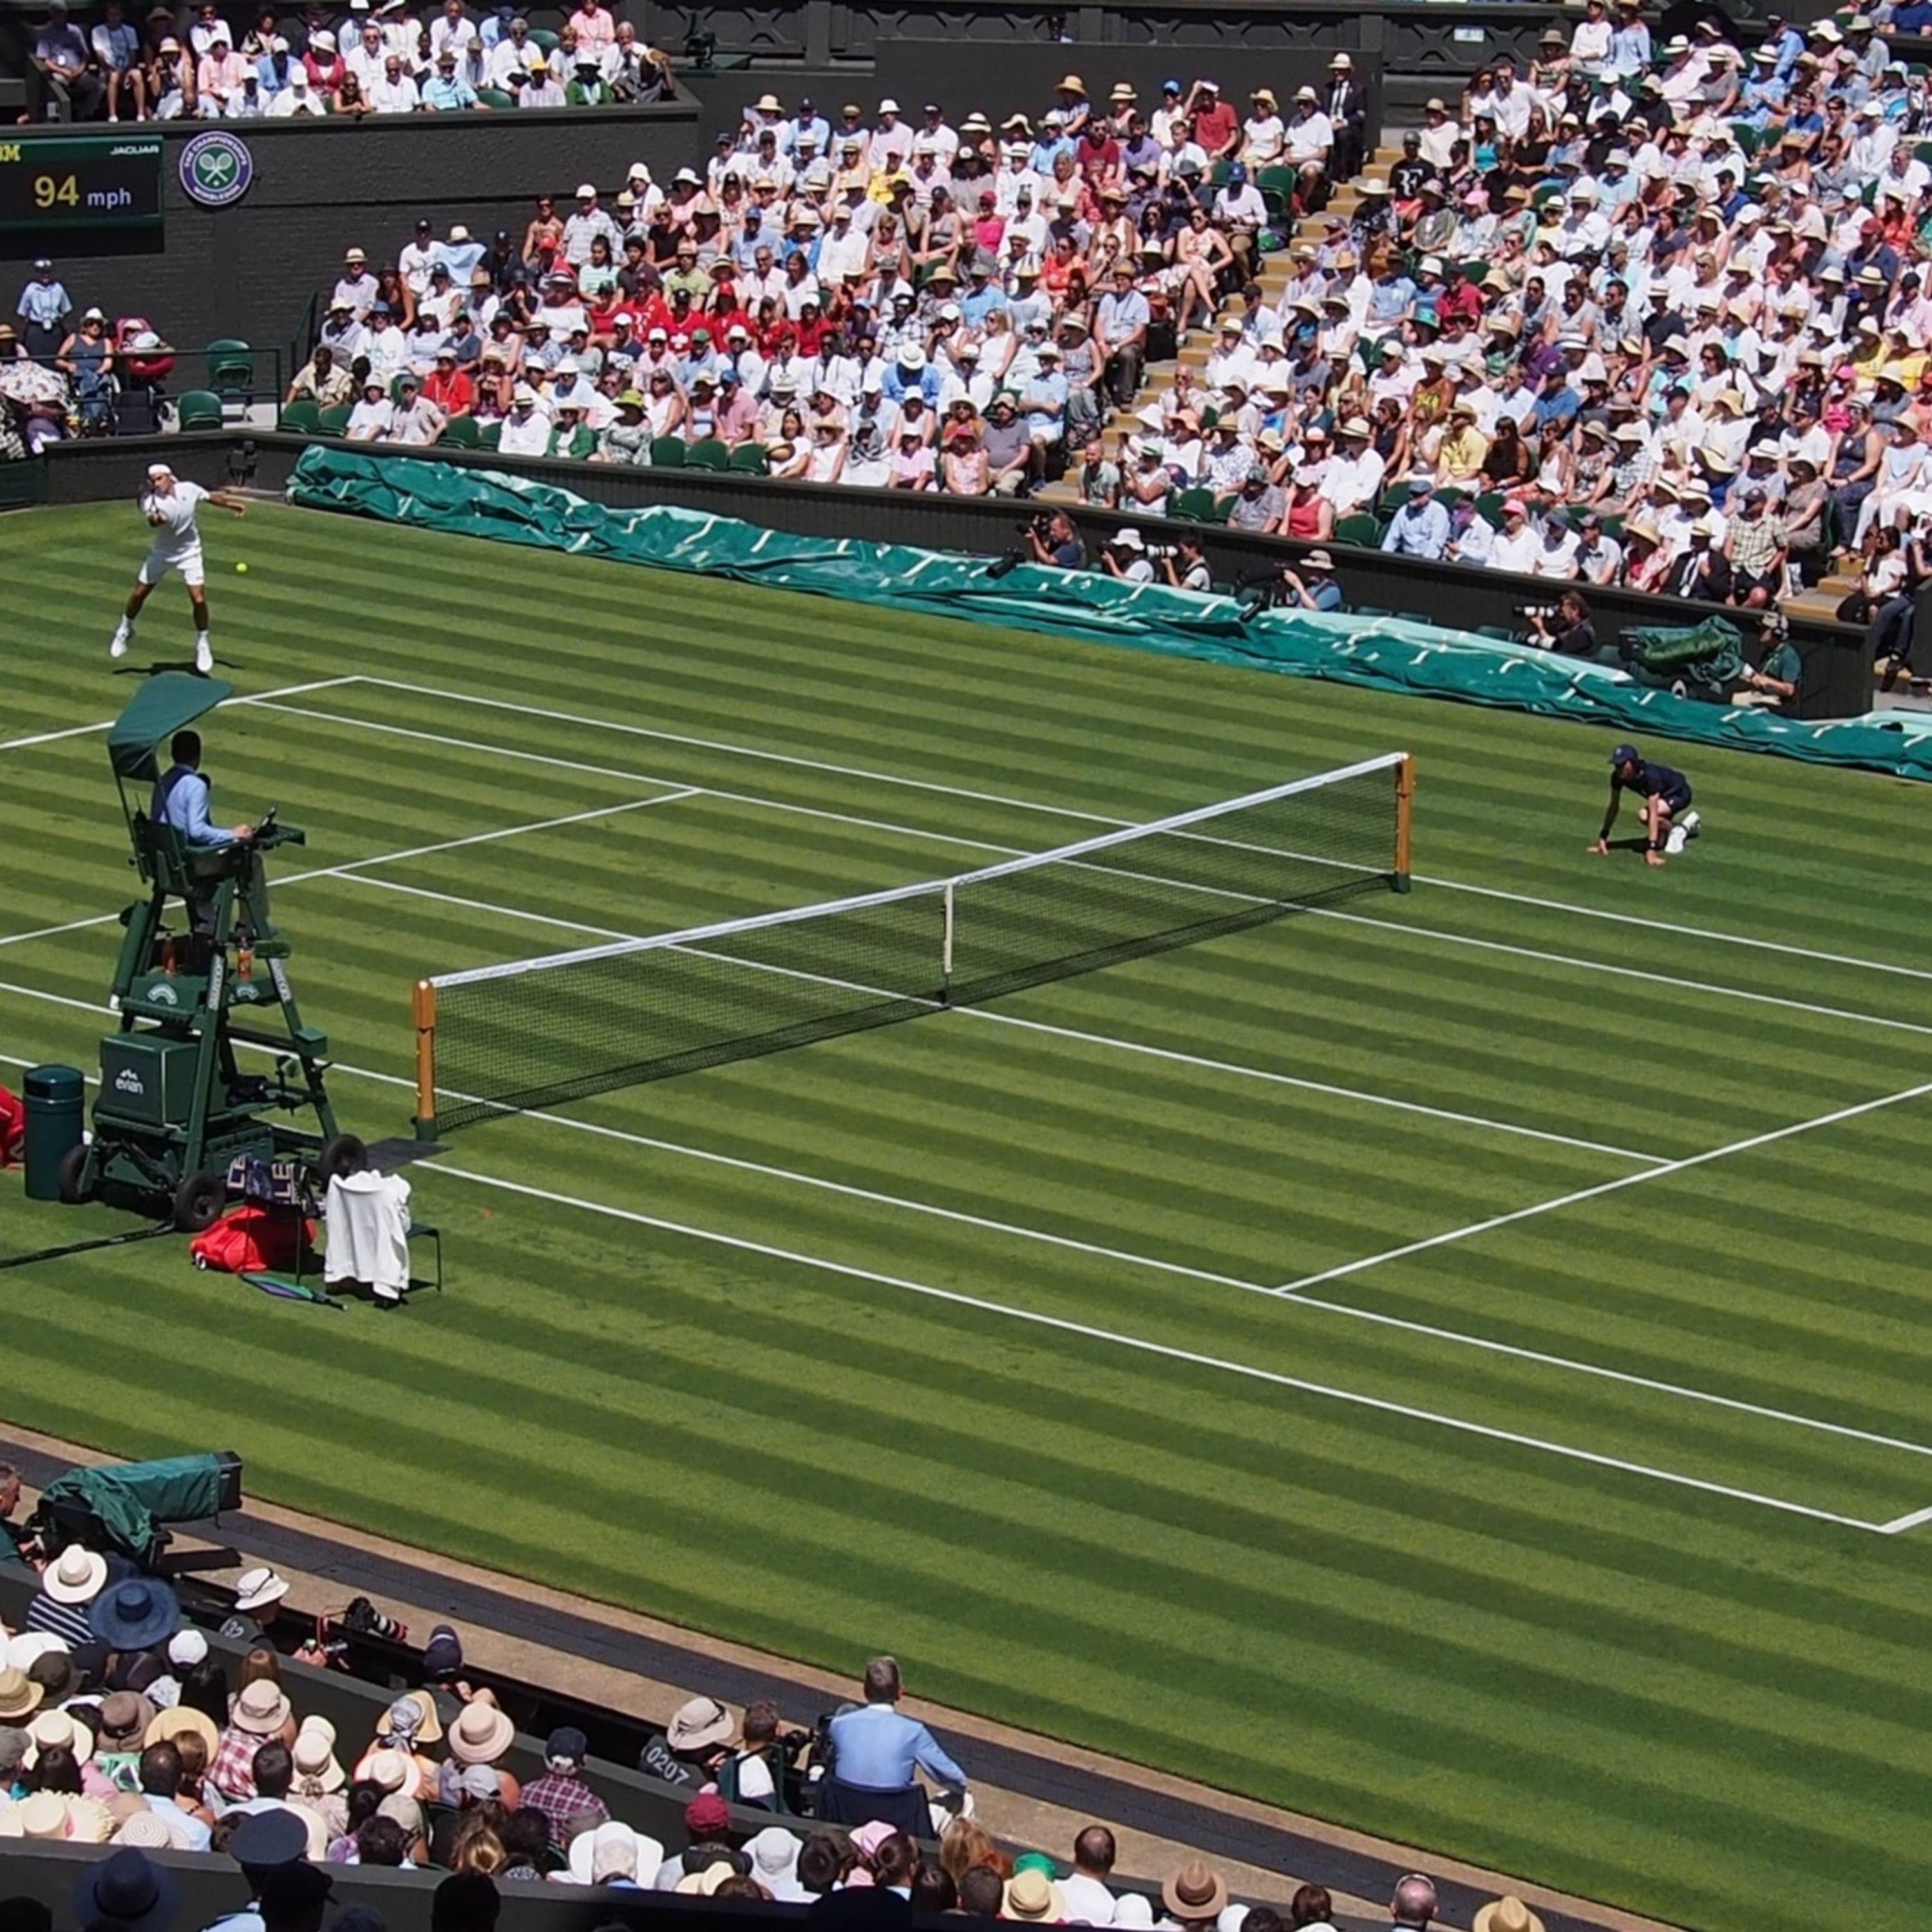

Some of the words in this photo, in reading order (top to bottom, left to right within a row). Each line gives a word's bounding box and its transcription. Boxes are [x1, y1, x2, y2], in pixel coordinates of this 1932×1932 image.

[110, 144, 160, 156] JAGUAR
[34, 175, 80, 207] 94
[87, 187, 131, 209] mph
[115, 1077, 144, 1095] evian
[646, 1746, 690, 1785] 0207
